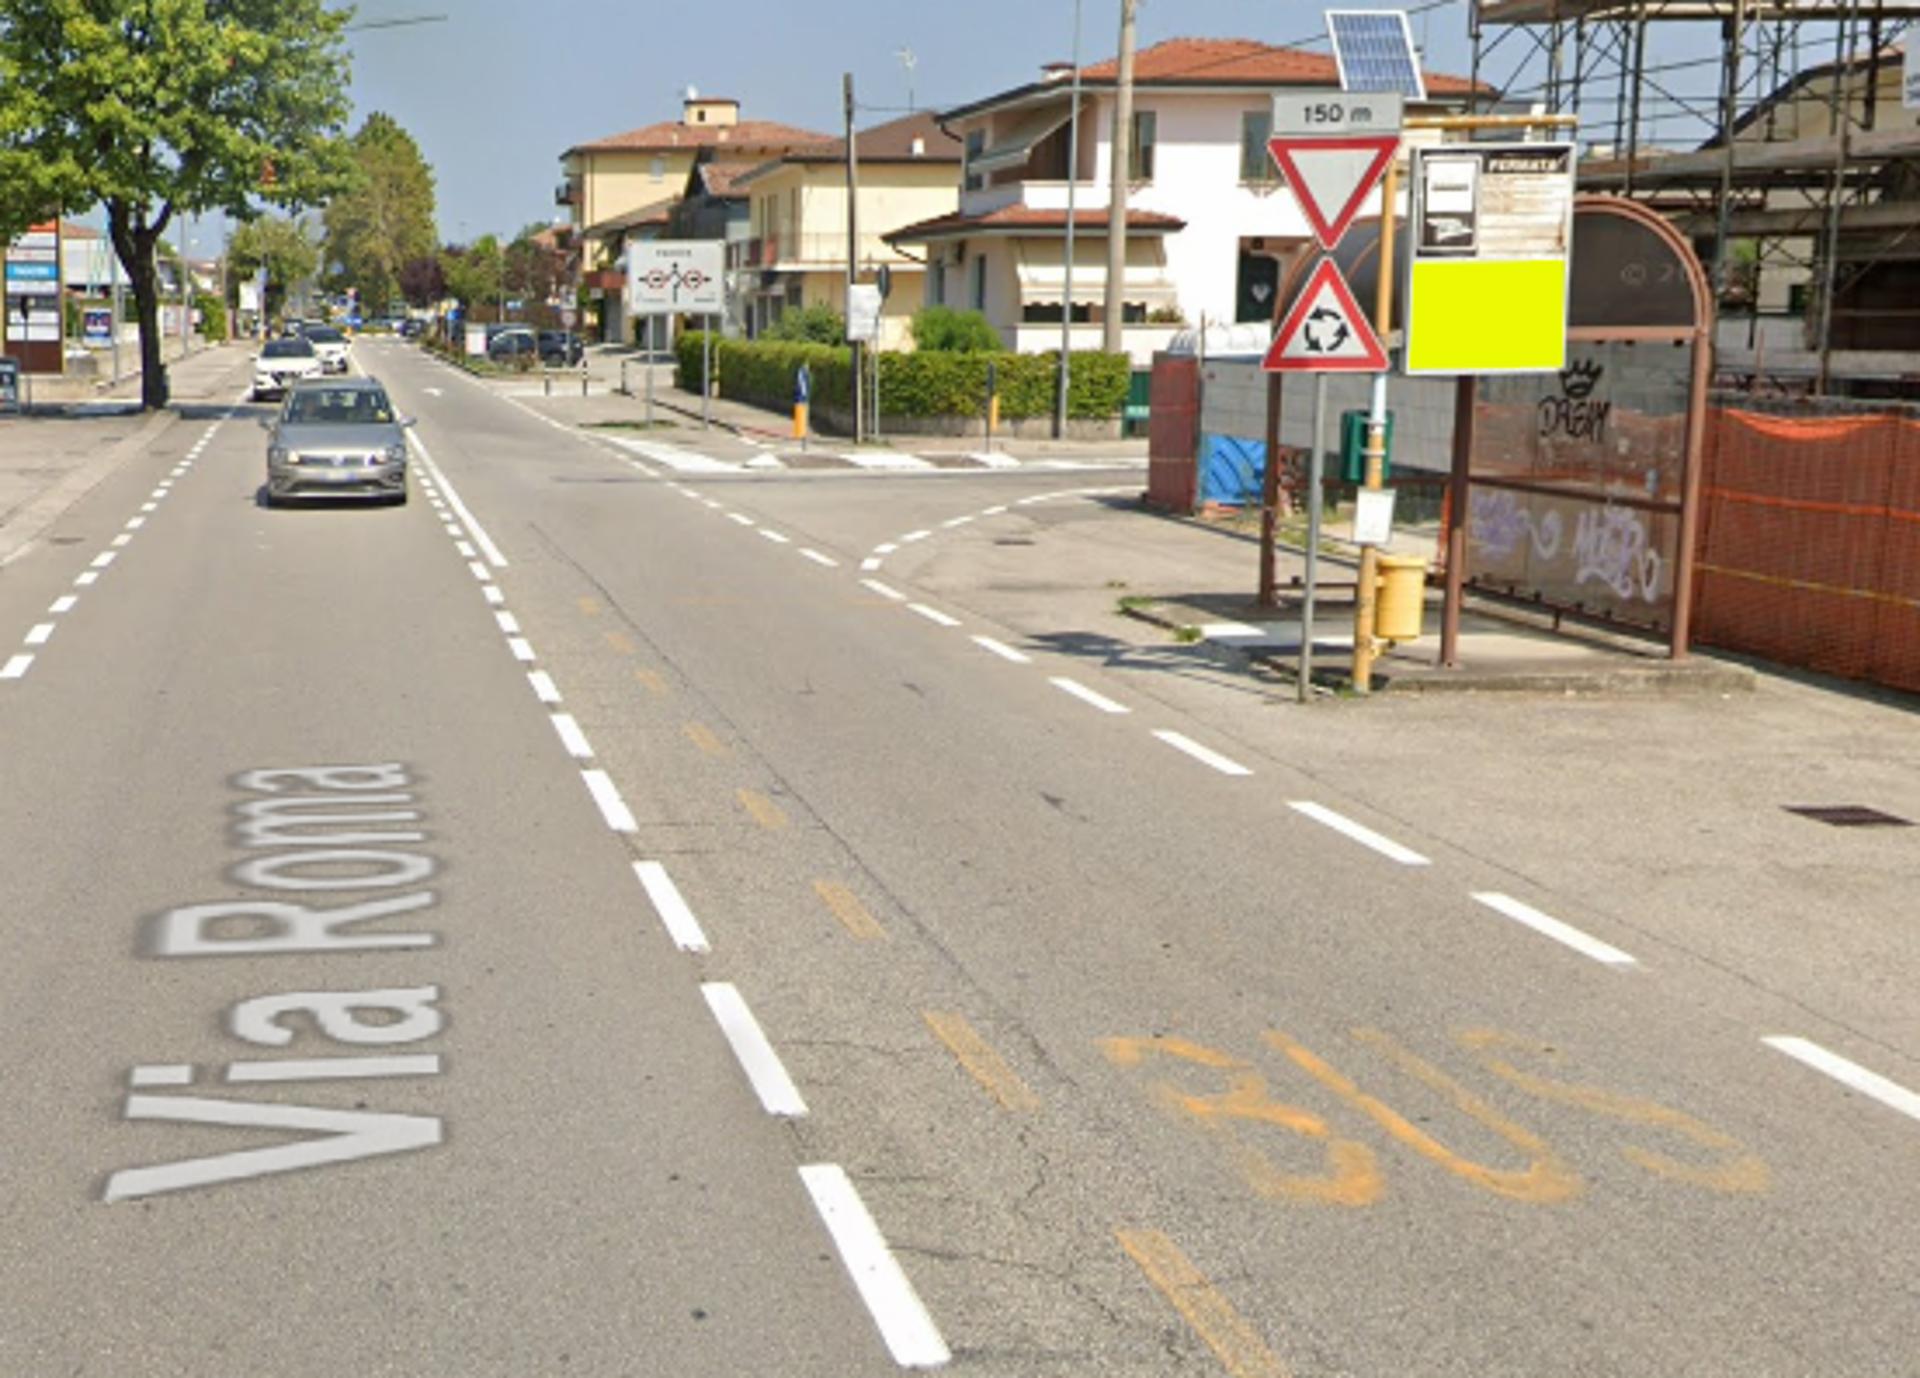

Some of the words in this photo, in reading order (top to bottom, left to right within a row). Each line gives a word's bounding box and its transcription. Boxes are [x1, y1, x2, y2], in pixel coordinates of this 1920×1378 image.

[1304, 103, 1344, 123] 150
[1350, 106, 1372, 122] m
[1097, 1027, 1773, 1207] BUS
